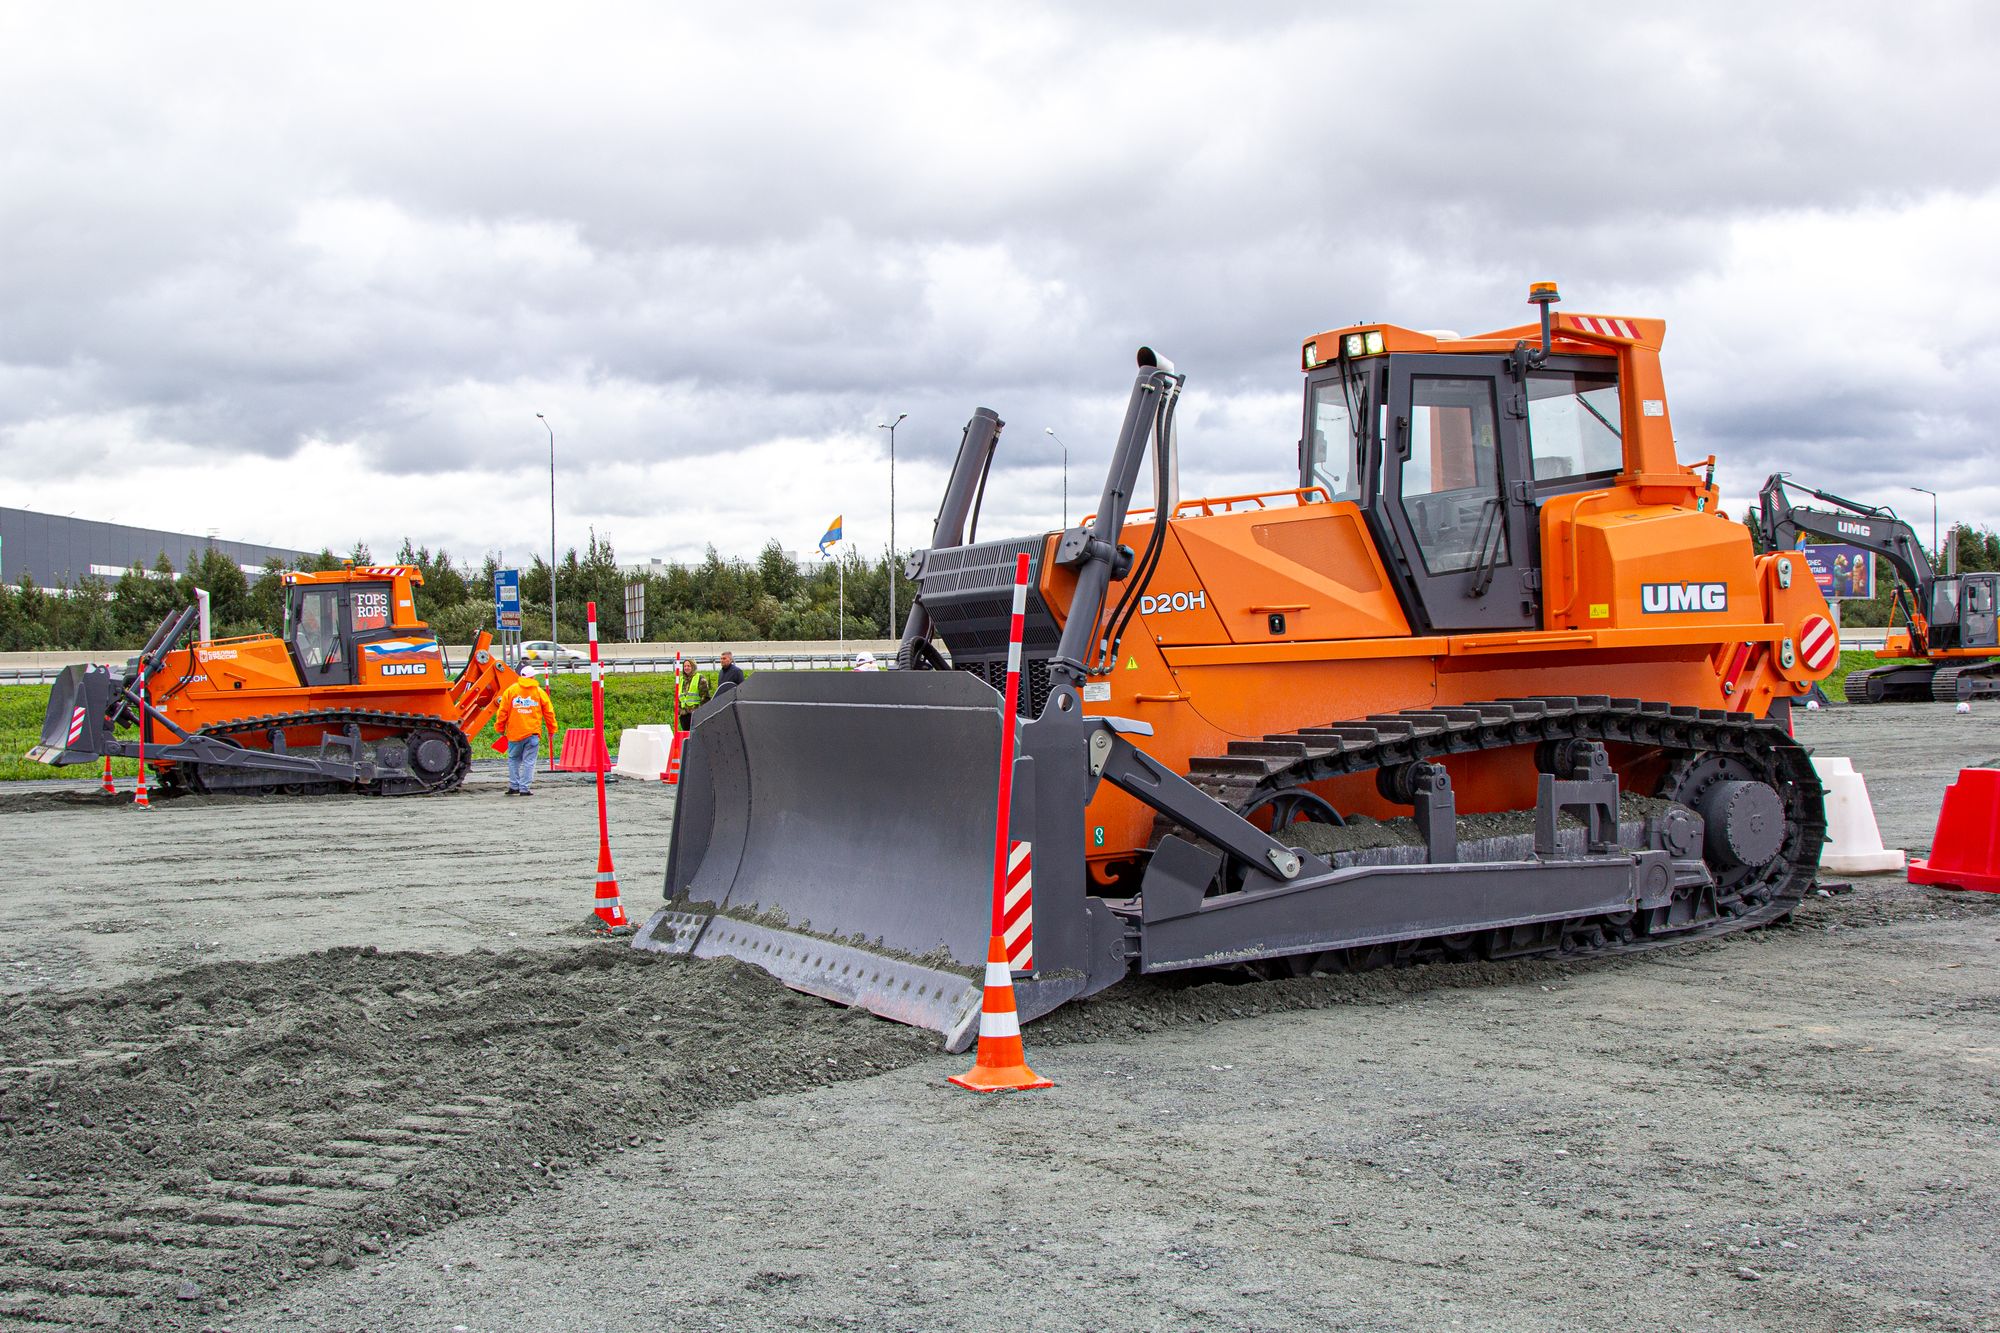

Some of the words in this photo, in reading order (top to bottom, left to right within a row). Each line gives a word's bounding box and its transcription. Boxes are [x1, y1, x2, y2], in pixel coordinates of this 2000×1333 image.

[1838, 521, 1870, 537] UMG
[357, 594, 388, 605] FOPS
[1140, 590, 1206, 615] D20H
[1643, 584, 1726, 611] UMG
[357, 606, 388, 617] ROPS
[382, 664, 426, 675] UMG
